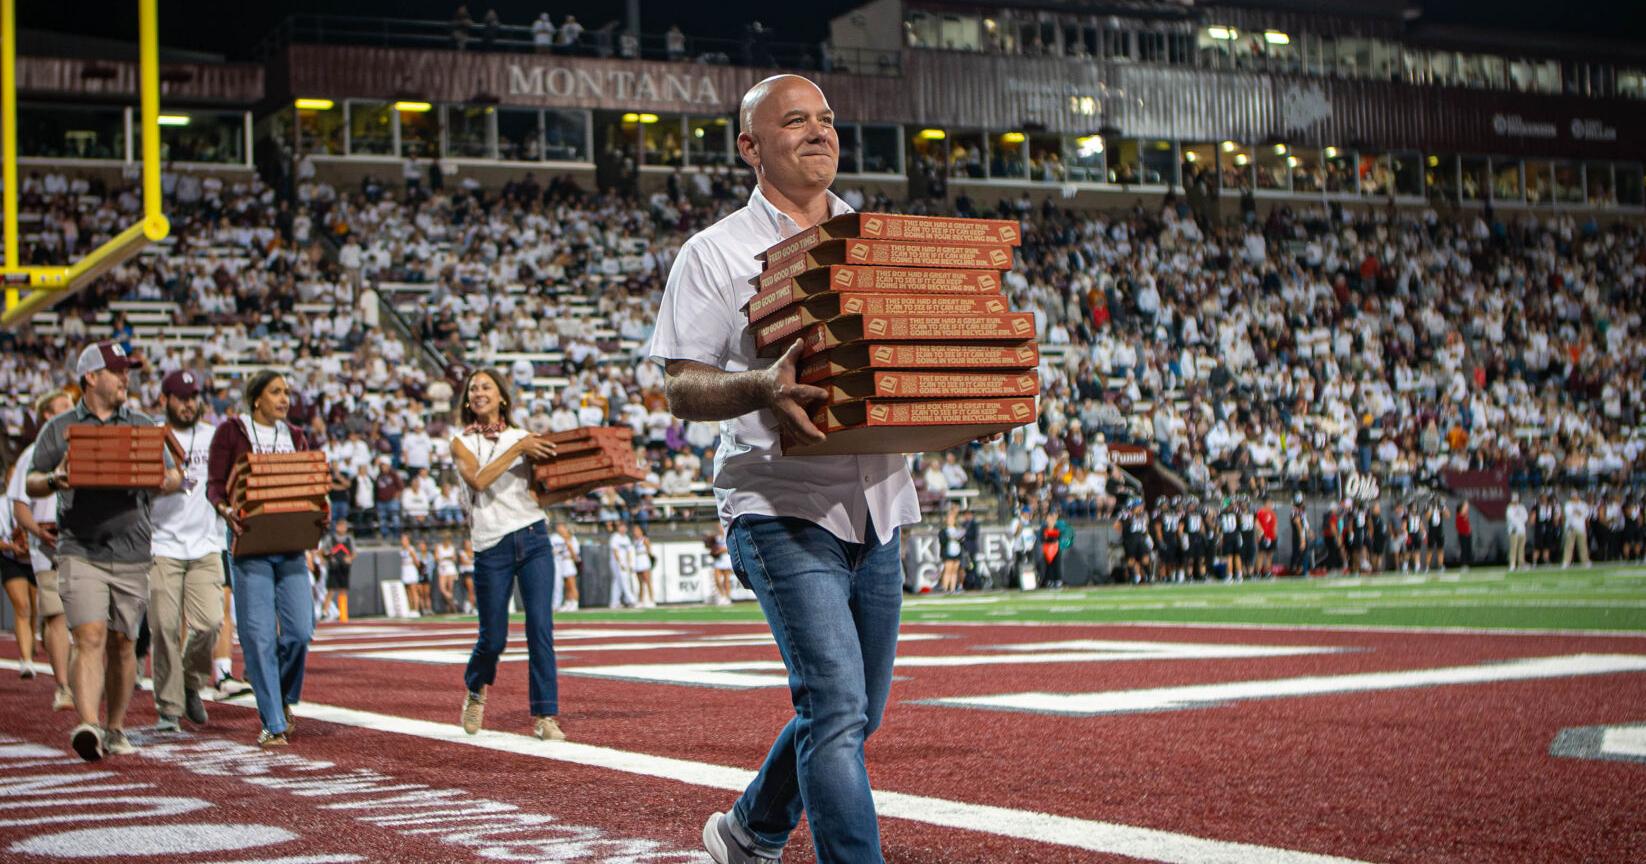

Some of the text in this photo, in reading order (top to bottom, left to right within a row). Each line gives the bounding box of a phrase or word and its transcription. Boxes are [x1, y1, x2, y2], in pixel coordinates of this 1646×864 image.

[509, 65, 721, 104] MONTANA
[782, 242, 799, 257] GOOD
[774, 268, 789, 283] GOOD
[762, 293, 776, 307] GOOD
[1112, 450, 1147, 464] Tunnel
[680, 581, 699, 592] RV
